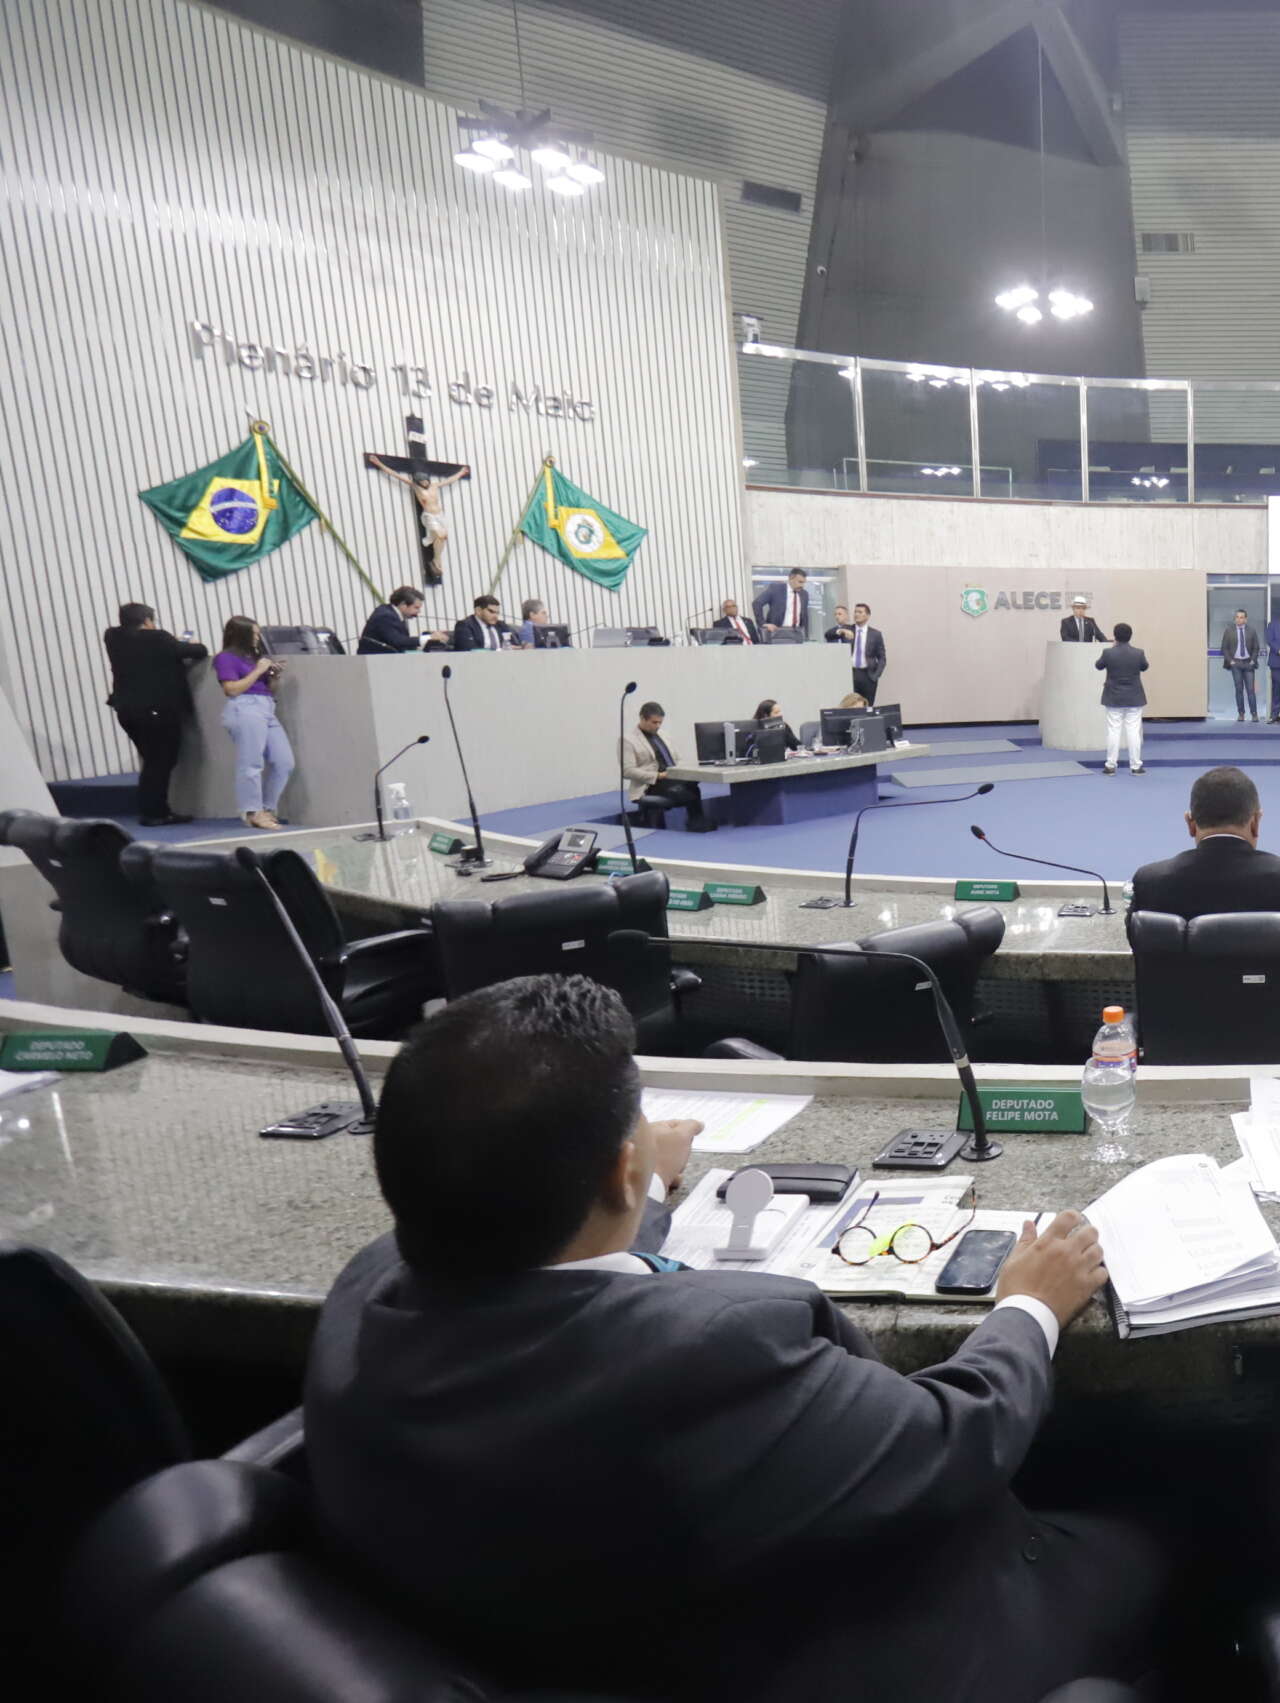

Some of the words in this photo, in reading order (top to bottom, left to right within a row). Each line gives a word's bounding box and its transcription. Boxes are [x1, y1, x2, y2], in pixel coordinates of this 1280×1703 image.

[189, 319, 377, 391] Plenário
[391, 363, 432, 399] 13
[449, 370, 495, 409] de
[509, 379, 595, 422] Maio
[994, 591, 1062, 610] ALECE
[31, 1041, 85, 1050] DEPUTADO
[992, 1099, 1055, 1110] DEPUTADO
[985, 1111, 1021, 1121] FELIPE
[1023, 1111, 1059, 1121] MOTA
